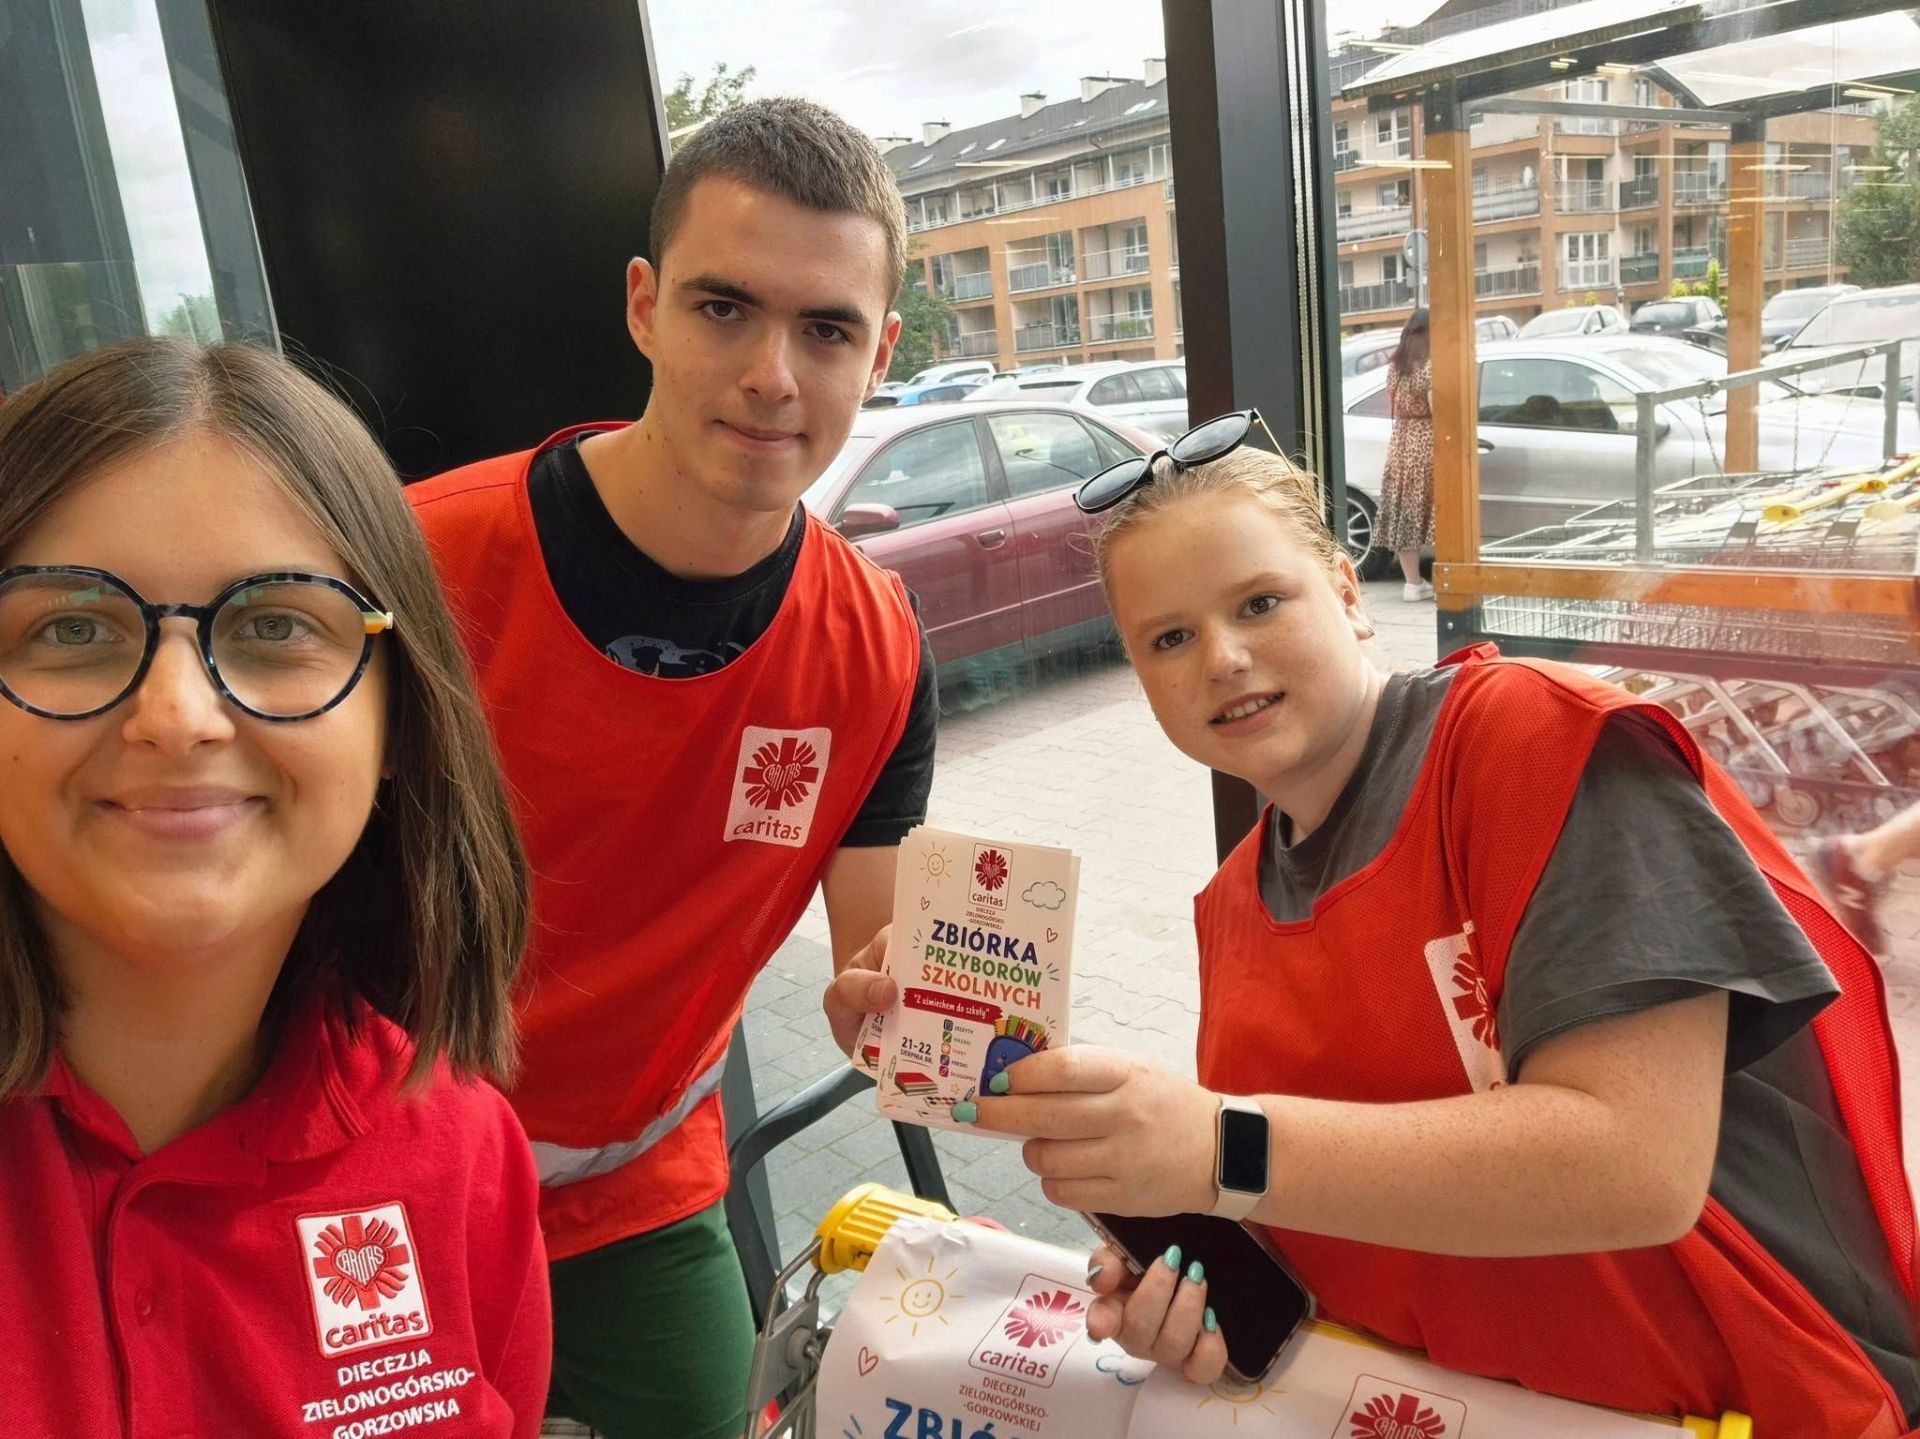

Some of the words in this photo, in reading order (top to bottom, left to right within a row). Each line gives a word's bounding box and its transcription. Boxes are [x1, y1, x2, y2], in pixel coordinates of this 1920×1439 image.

[733, 816, 802, 840] caritas
[972, 893, 1004, 907] caritas
[931, 919, 1038, 965] ZBIÓRKA
[924, 944, 1042, 987] PRZYBORÓW
[921, 964, 1042, 1010] SZKOLNYCH
[956, 1003, 964, 1013] do
[901, 1036, 932, 1056] 21-22
[325, 1310, 424, 1348] caritas
[337, 1349, 432, 1387] DIECEZJA
[980, 1350, 1049, 1379] caritas
[302, 1367, 476, 1422] ZIELONOGÓRSKO-
[959, 1385, 1050, 1418] ZIELONOGÓRSKO-
[982, 1376, 1026, 1399] DIECEZJI
[333, 1397, 460, 1439] GORZOWSKA
[963, 1401, 1041, 1432] -GORZOWSKIEJ
